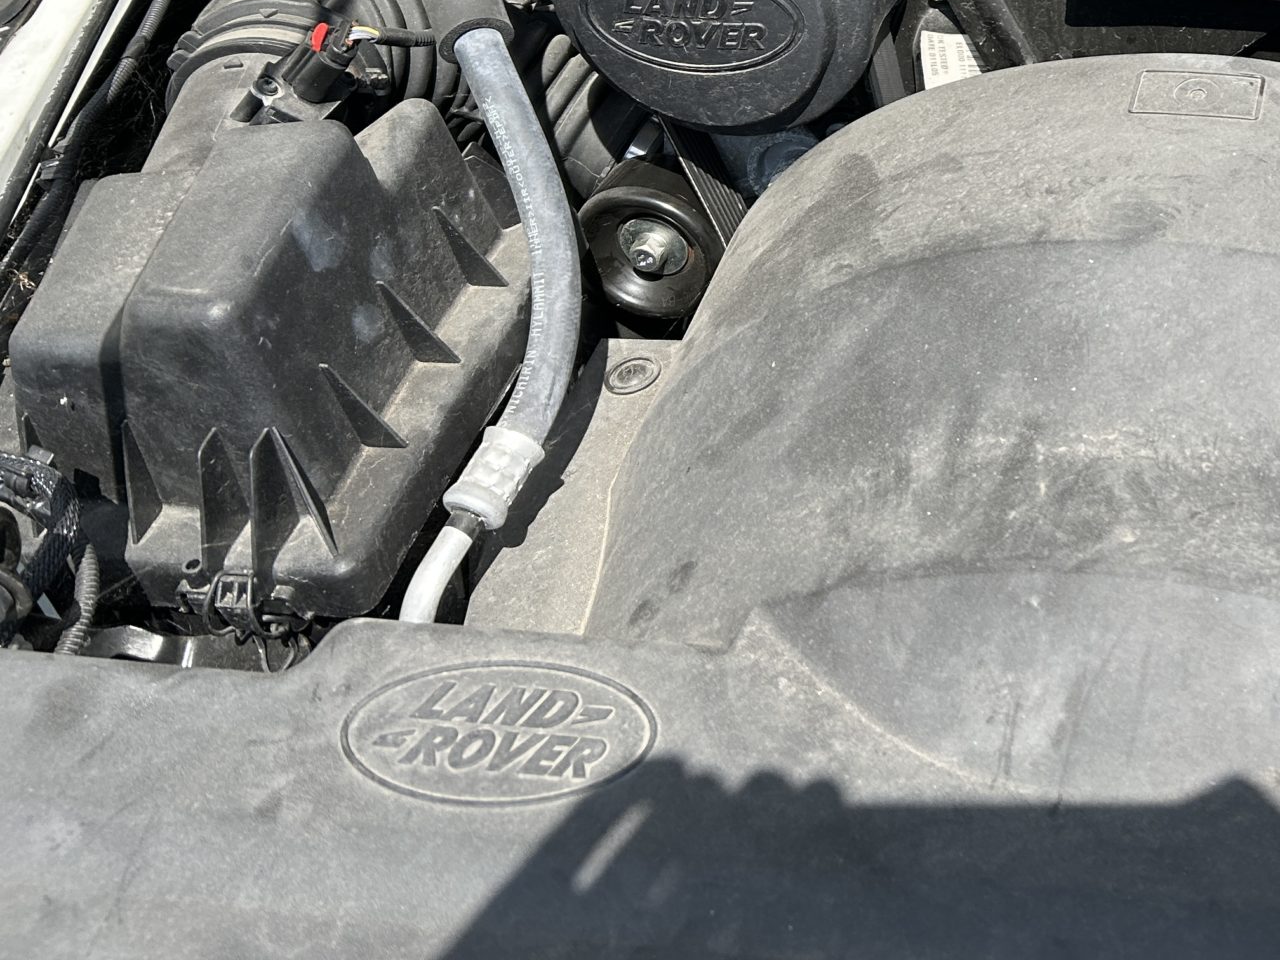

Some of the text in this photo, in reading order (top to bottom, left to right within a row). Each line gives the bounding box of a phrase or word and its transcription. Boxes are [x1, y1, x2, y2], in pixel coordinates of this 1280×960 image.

[638, 16, 768, 50] ROVER
[408, 680, 582, 729] LAND
[396, 725, 610, 780] ROVER
